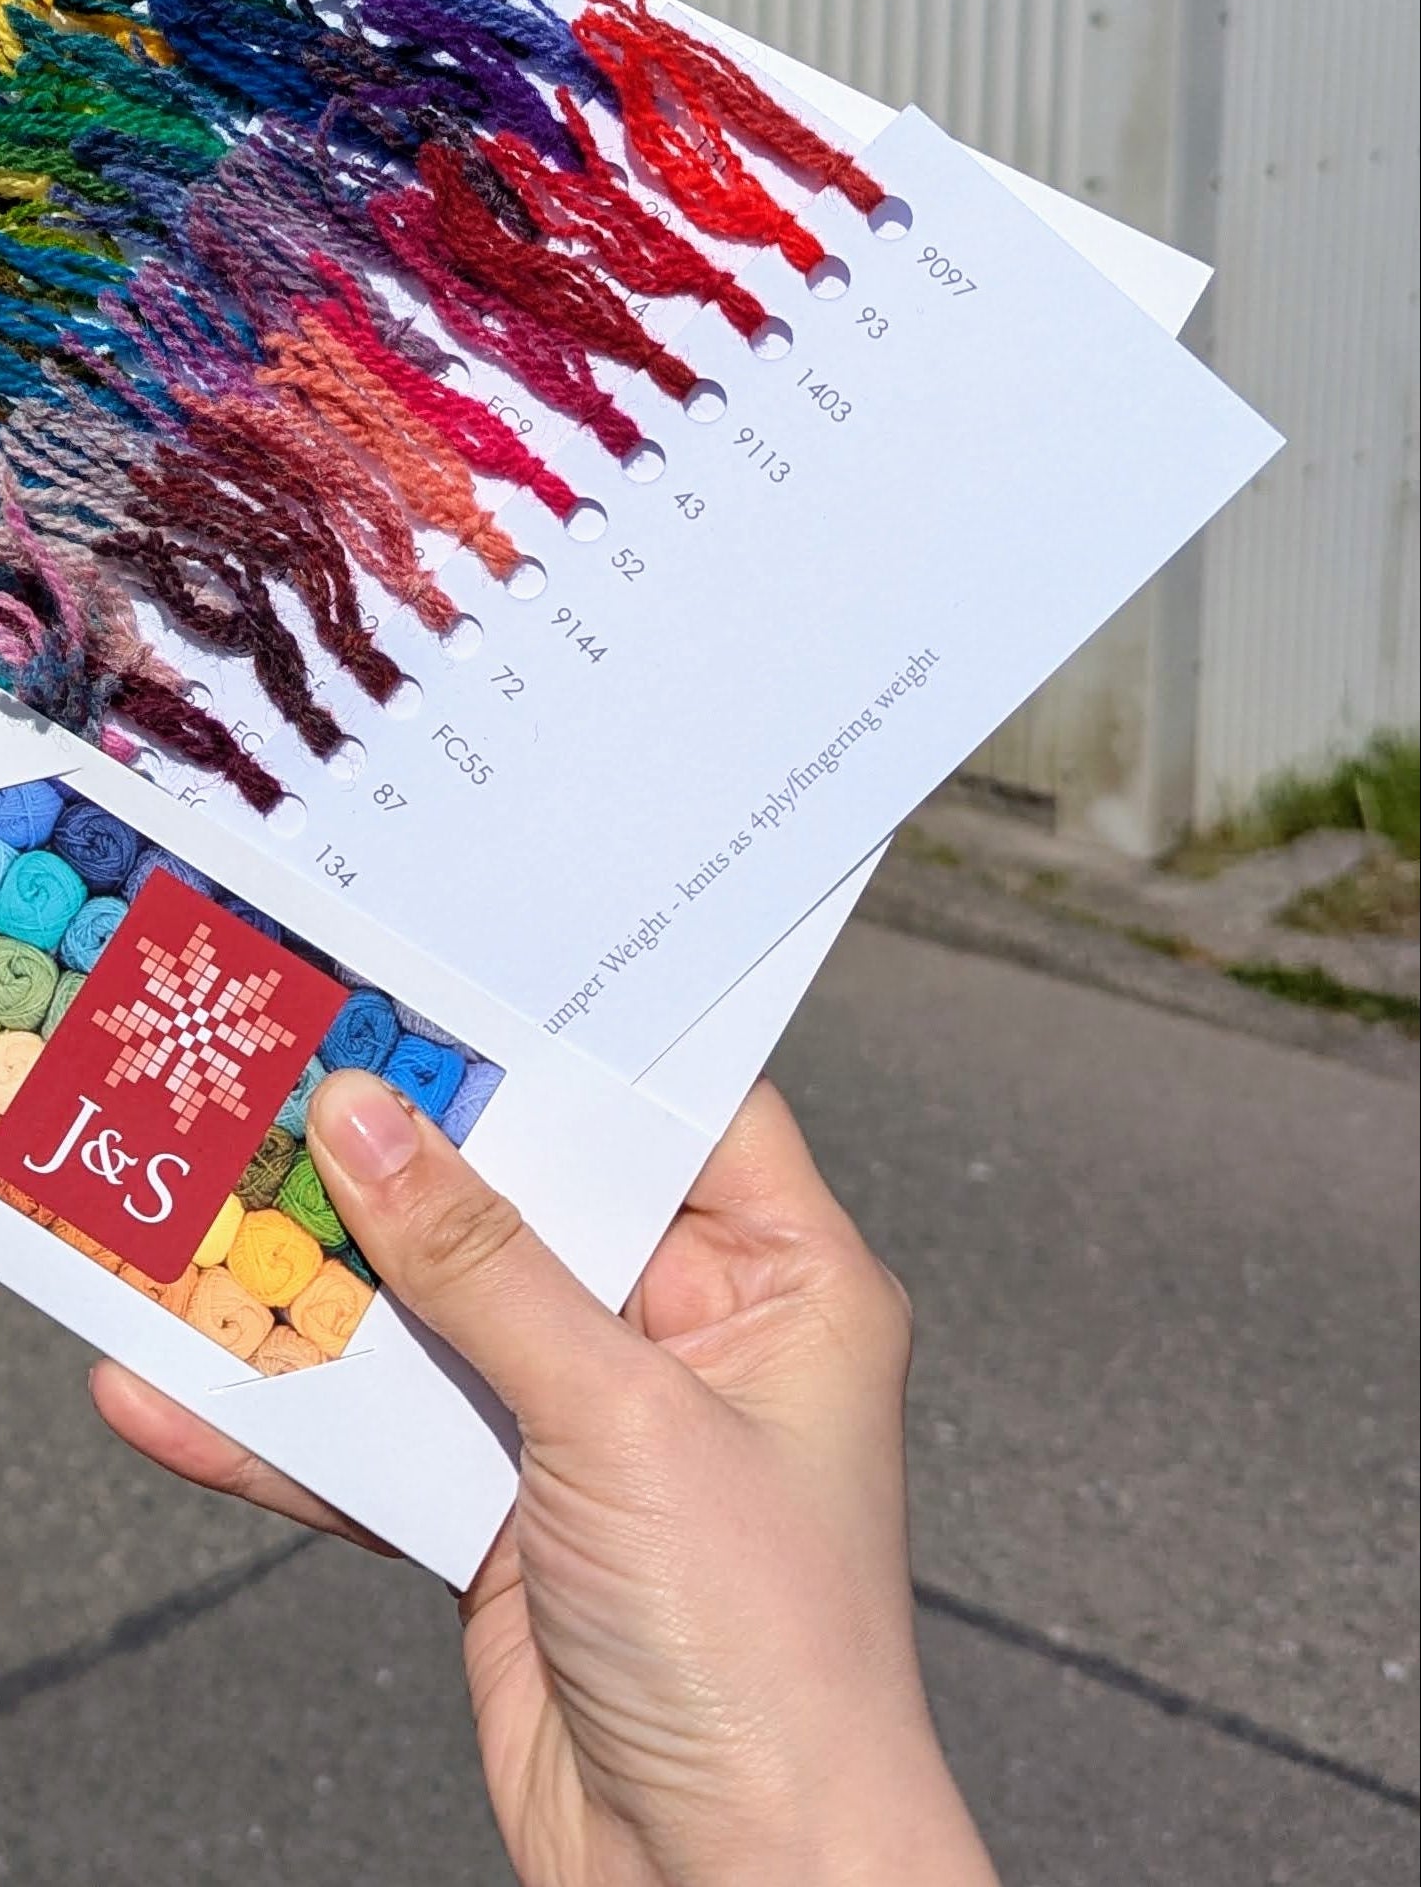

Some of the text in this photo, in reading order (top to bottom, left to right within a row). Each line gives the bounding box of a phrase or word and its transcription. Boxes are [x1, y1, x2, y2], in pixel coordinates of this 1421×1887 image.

[917, 246, 978, 296] 9097
[855, 307, 889, 339] 93
[797, 368, 852, 422] 1403
[733, 427, 790, 483] 9113
[674, 492, 705, 520] 43
[611, 548, 645, 582] 52
[551, 608, 608, 664] 9144
[491, 665, 524, 701] 72
[431, 724, 494, 785] FC55
[373, 784, 408, 811] 87
[543, 644, 942, 1036] umper Weight knits as 4ply/fingering weight
[316, 844, 358, 888] 134
[22, 1094, 191, 1225] J&S
